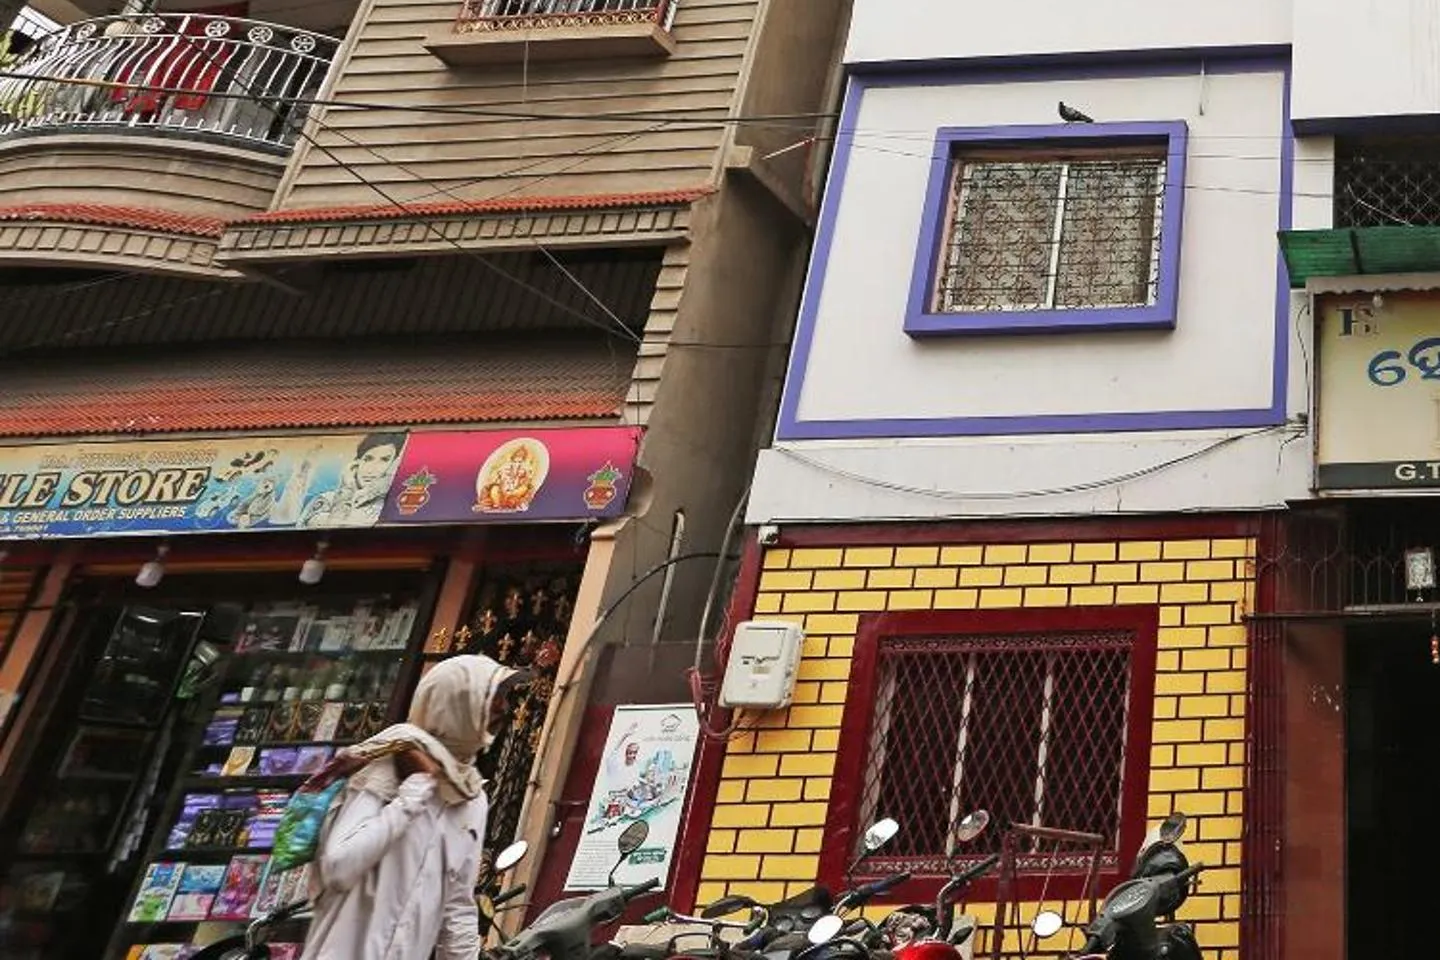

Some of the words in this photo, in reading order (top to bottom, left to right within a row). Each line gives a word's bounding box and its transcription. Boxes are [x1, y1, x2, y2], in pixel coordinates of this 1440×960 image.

[0, 471, 61, 509] LE
[60, 466, 211, 508] STORE
[13, 510, 70, 524] GENERAL
[73, 508, 116, 521] ORDER
[117, 505, 187, 520] SUPPLIERS
